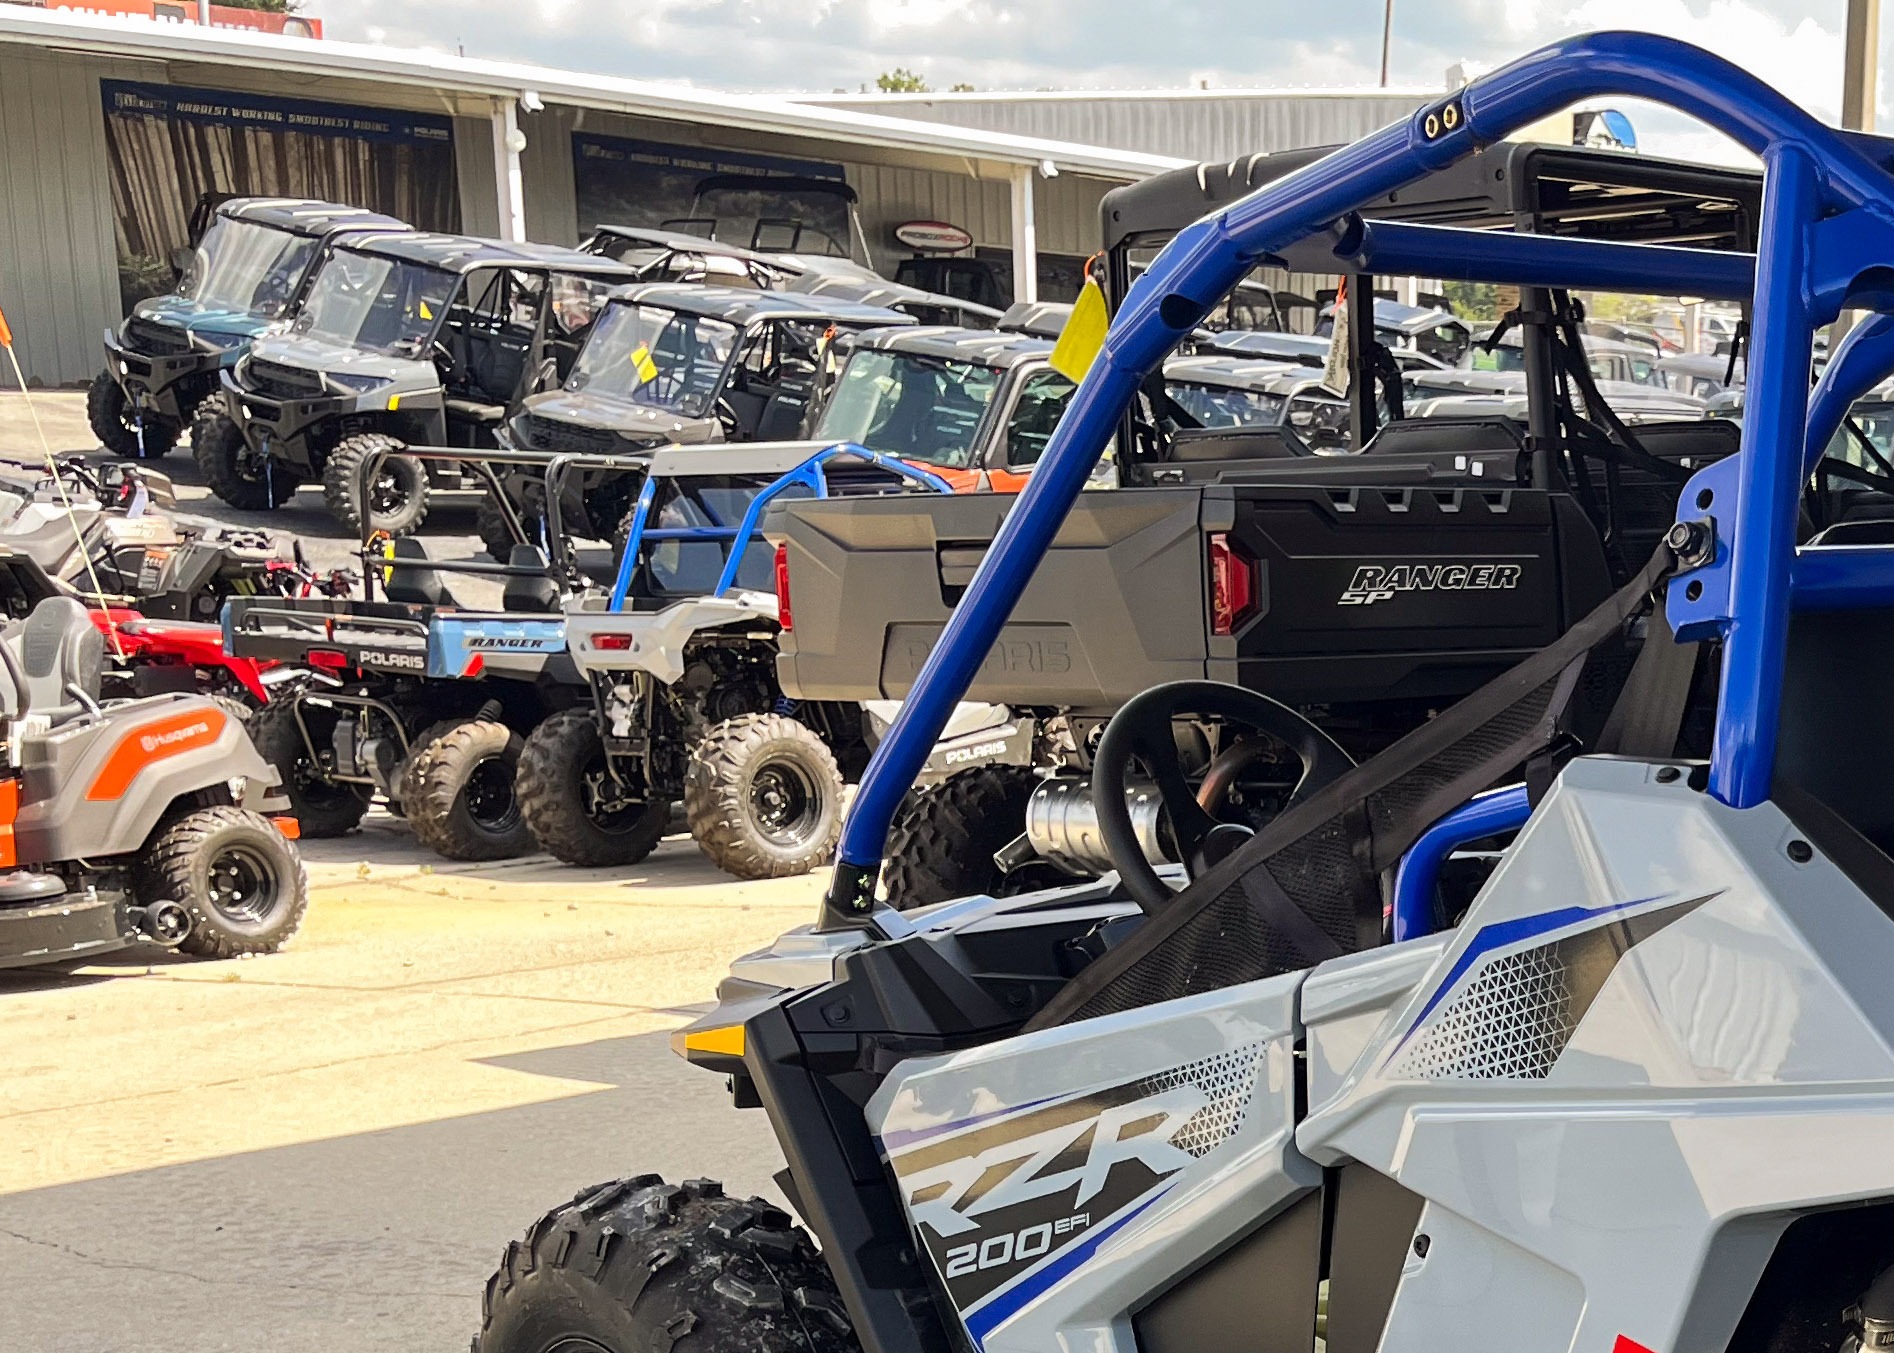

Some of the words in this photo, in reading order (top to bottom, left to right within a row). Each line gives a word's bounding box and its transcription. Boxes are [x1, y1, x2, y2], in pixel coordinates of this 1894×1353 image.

[1348, 565, 1522, 592] RANGER
[1337, 590, 1395, 606] SP
[468, 637, 544, 649] RANGER
[904, 639, 1072, 673] PARIS
[359, 650, 425, 669] POLARIS
[945, 740, 1008, 766] POLARIS
[899, 1083, 1209, 1238] RZR
[946, 1222, 1052, 1280] 200
